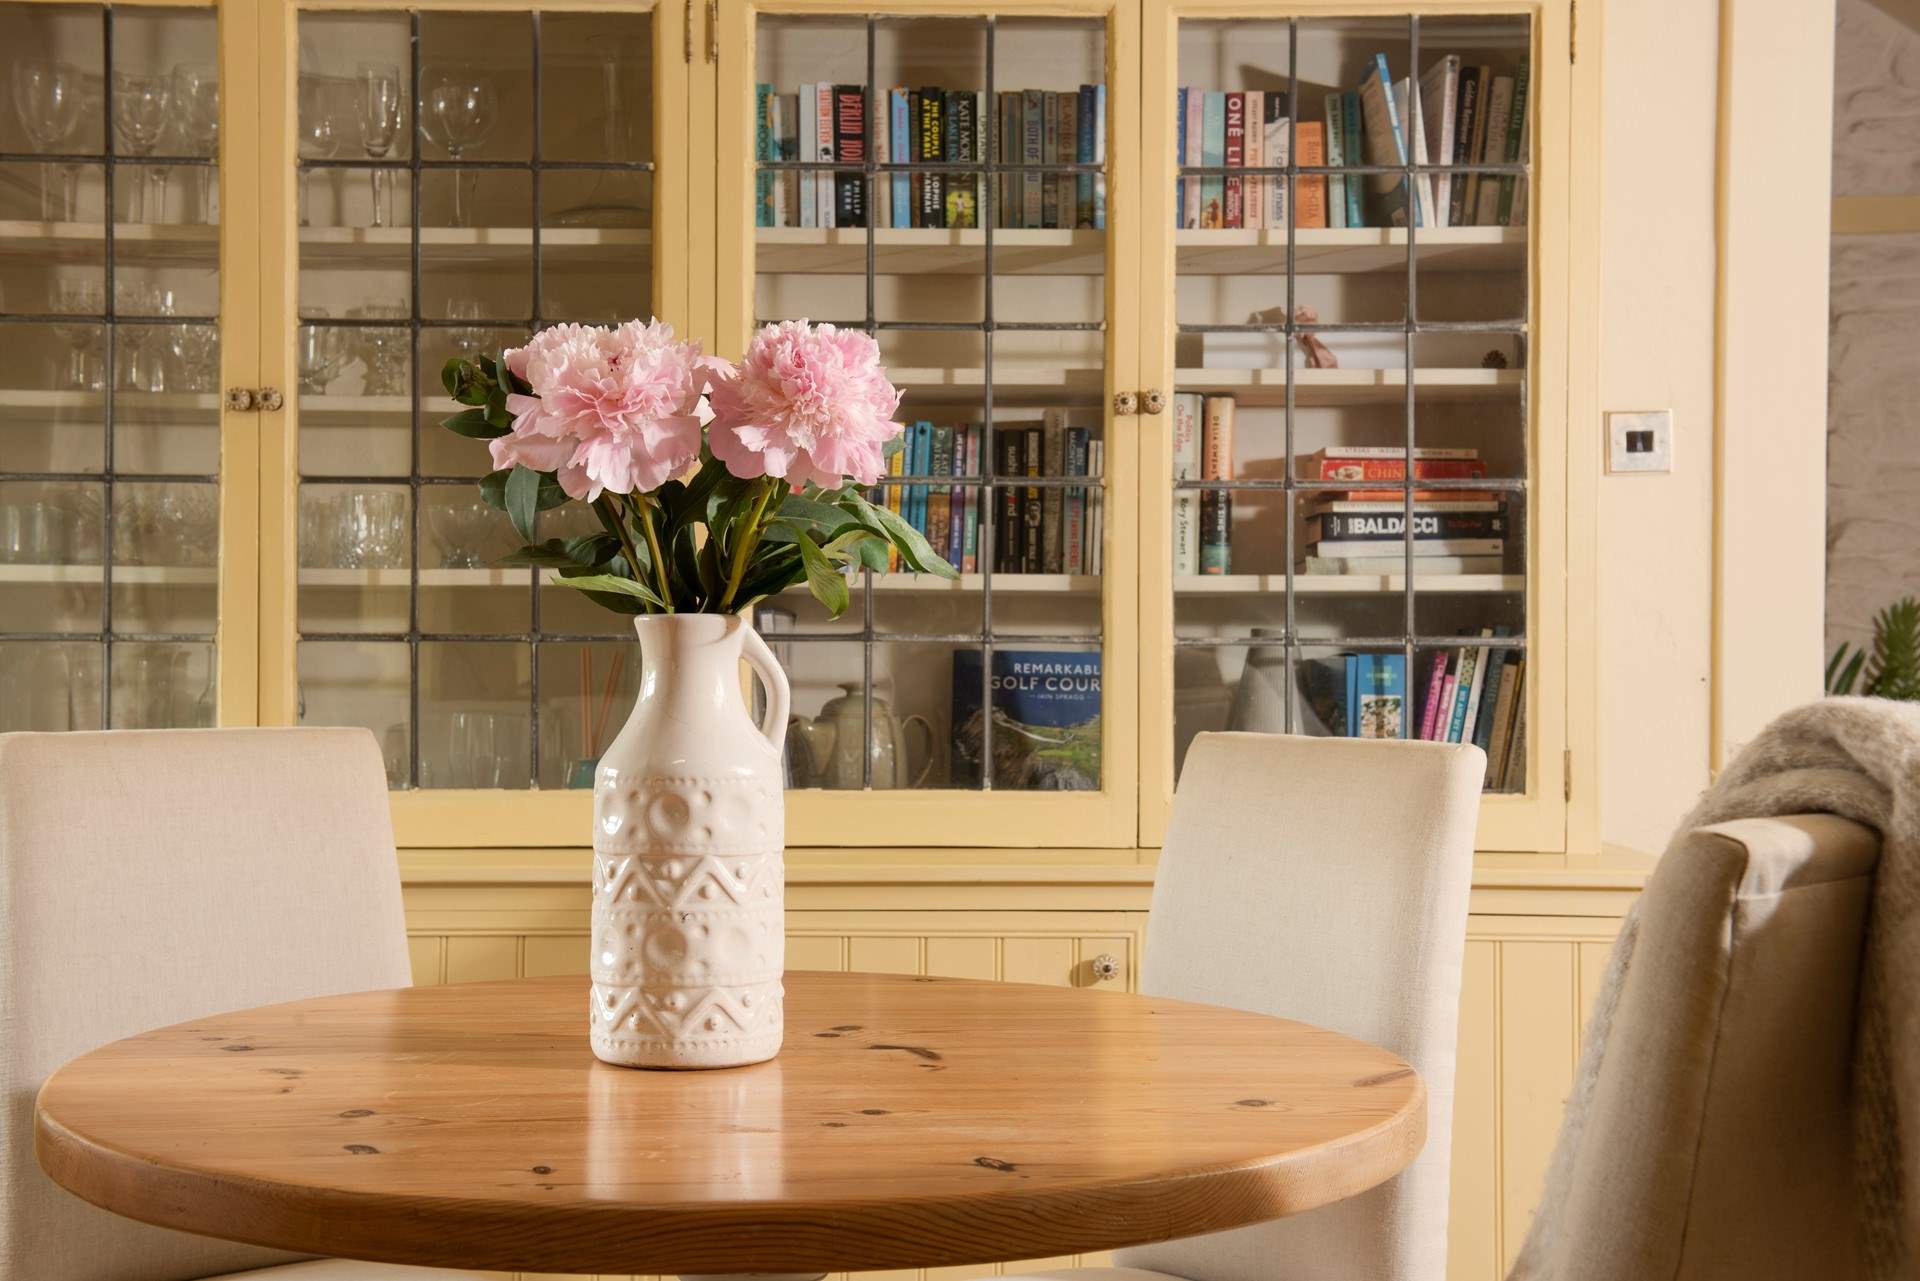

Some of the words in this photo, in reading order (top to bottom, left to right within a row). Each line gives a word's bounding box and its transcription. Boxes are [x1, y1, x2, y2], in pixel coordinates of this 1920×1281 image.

[923, 98, 931, 110] AT
[1463, 79, 1476, 108] Golden
[840, 94, 863, 134] BERLIN
[923, 112, 931, 129] THE
[932, 101, 940, 118] THE
[958, 100, 970, 128] KATE
[1061, 96, 1072, 149] PLAYING
[932, 120, 940, 156] COUPLE
[1027, 120, 1039, 144] BOTH
[1460, 109, 1472, 145] Retriever
[840, 139, 863, 162] NOI
[923, 131, 931, 158] TABLE
[959, 130, 970, 181] MORTN
[1027, 147, 1040, 160] OF
[1227, 146, 1240, 186] LIE
[844, 184, 852, 211] KERR
[854, 180, 862, 215] PHILIP
[923, 172, 931, 214] HANNAH
[931, 174, 939, 209] SOPHIE
[1176, 403, 1184, 417] On
[1176, 418, 1184, 432] the
[1185, 415, 1193, 442] Politics
[1067, 431, 1077, 477] MACINTYR
[1076, 447, 1084, 465] BEN
[1175, 433, 1183, 453] Edge
[1008, 446, 1016, 472] sushi
[1367, 467, 1422, 480] CHINE
[1179, 497, 1188, 518] Rory
[1217, 510, 1225, 532] SING
[1353, 517, 1438, 534] BALDACCI
[1179, 520, 1187, 555] Stewart
[1013, 662, 1101, 675] REMARKABL
[991, 675, 1039, 690] GOLF
[1044, 676, 1101, 691] COUR
